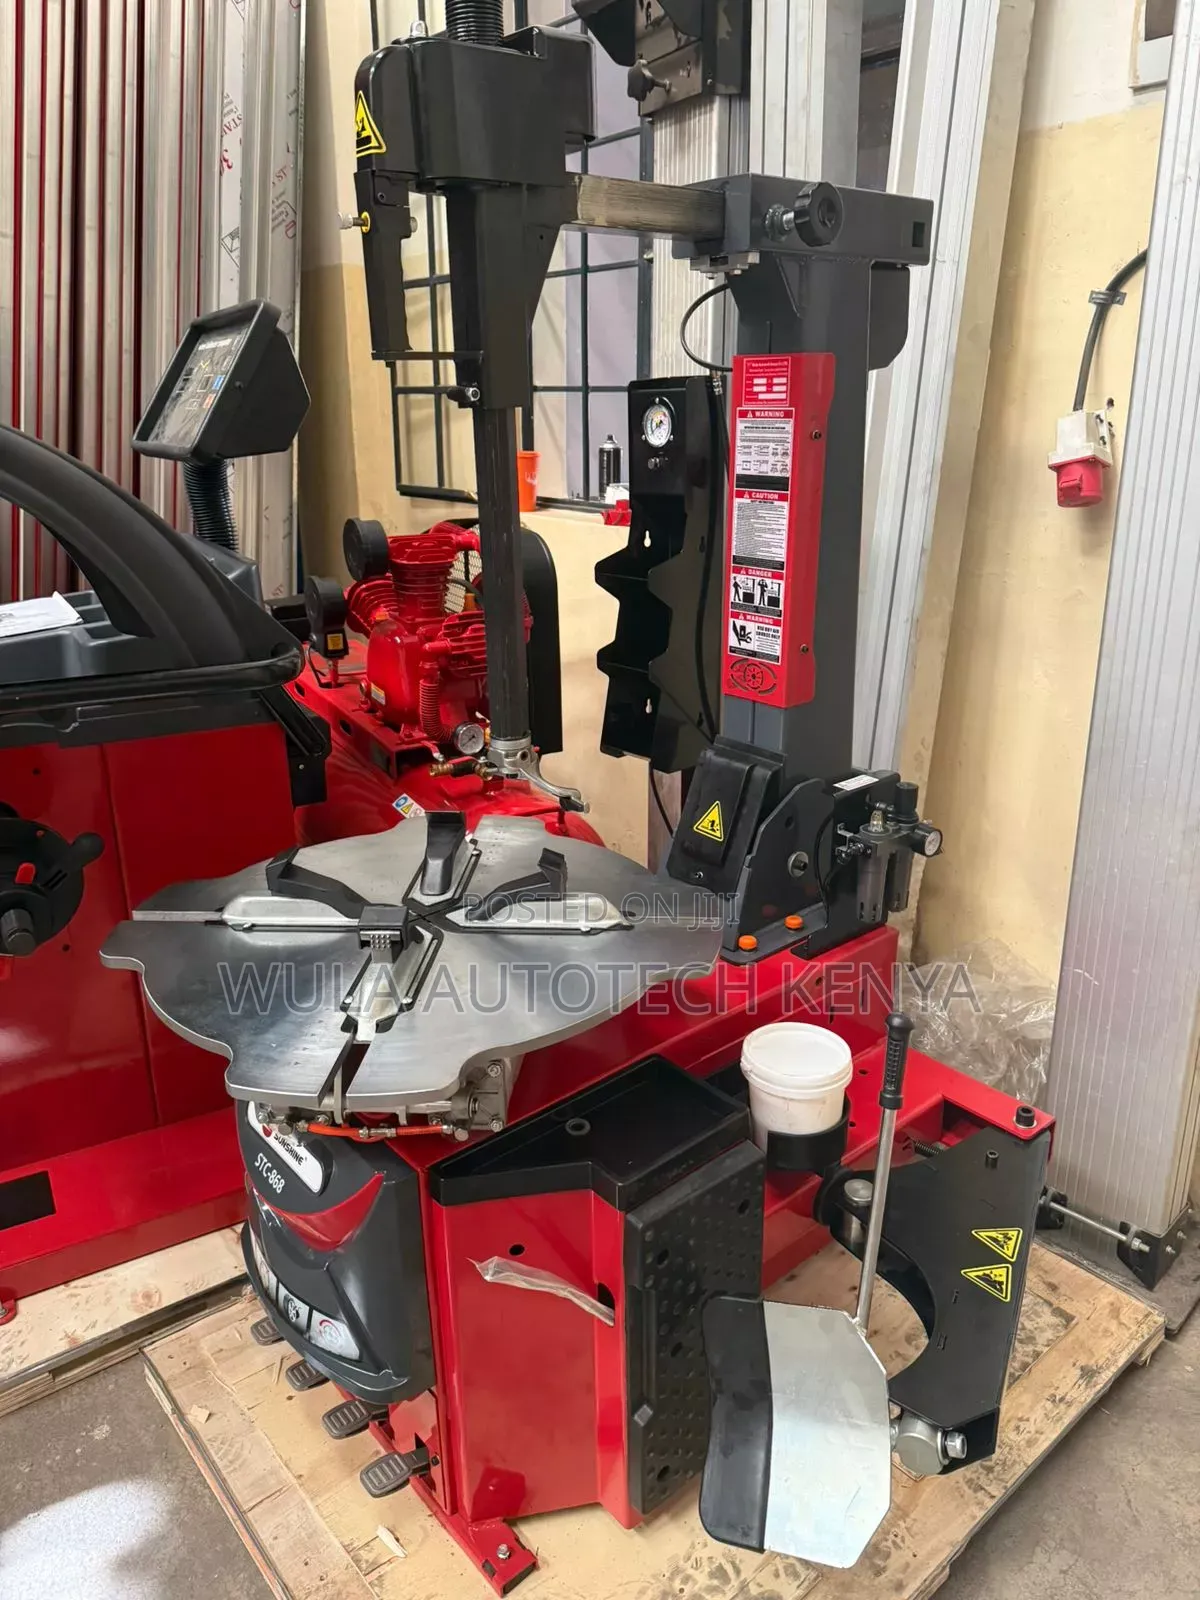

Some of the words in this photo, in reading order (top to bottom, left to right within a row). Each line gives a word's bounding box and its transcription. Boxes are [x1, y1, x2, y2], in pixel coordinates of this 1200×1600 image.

[751, 491, 779, 500] CAUTION
[748, 568, 772, 578] DANGER
[746, 614, 774, 624] WARNING
[274, 1133, 304, 1166] SUNSHINE
[254, 1152, 286, 1194] STC-868
